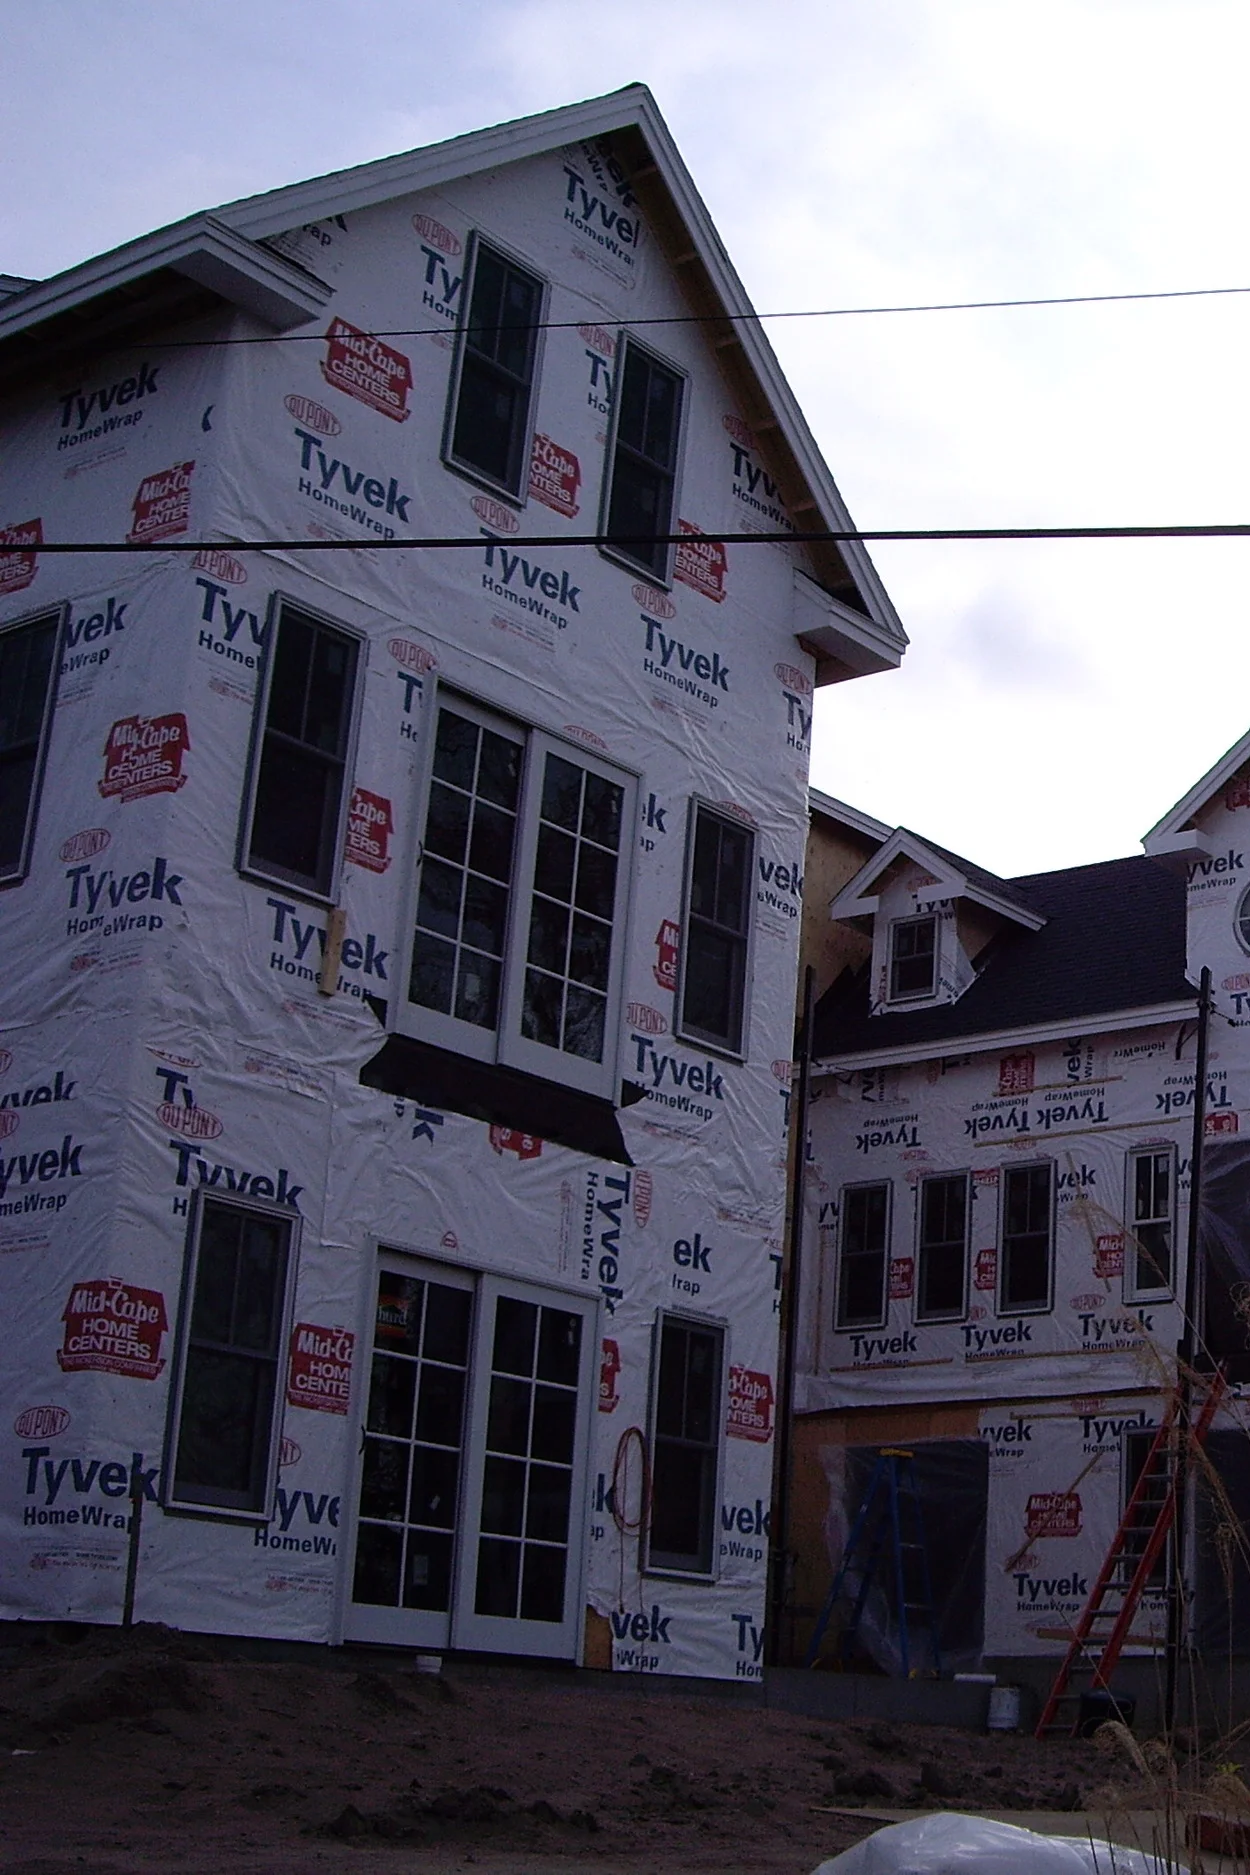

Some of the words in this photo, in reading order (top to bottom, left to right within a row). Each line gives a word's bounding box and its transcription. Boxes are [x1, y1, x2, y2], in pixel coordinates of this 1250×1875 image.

[563, 208, 635, 266] HomeWra
[331, 359, 401, 405] CENTERS
[344, 353, 392, 389] HOME
[58, 361, 160, 430] Tyvek
[57, 408, 143, 451] HomeWrap
[294, 428, 414, 523] Tyvek
[531, 461, 563, 490] OME
[534, 440, 576, 481] Cape
[142, 470, 191, 504] Mid-Ca
[530, 472, 573, 504] NTERS
[135, 504, 191, 534] CENTER
[299, 477, 396, 540] HomeWrap
[480, 527, 582, 613] Tyvek
[675, 555, 719, 588] ENTERS
[196, 577, 268, 645] Tyv
[481, 574, 568, 630] HomeWrap
[67, 597, 128, 648] vek
[60, 647, 110, 676] eWrap
[199, 631, 260, 668] Home
[640, 614, 729, 692] Tyvek
[643, 657, 719, 708] HomeWrap
[350, 793, 388, 827] Cape
[347, 831, 381, 855] TERS
[759, 855, 802, 900] vek
[1186, 850, 1244, 884] yvek
[65, 857, 183, 914] Tyvek
[1187, 876, 1237, 892] omeWrap
[756, 888, 798, 917] eWrap
[66, 914, 163, 938] HomeWrap
[630, 1033, 725, 1101] Tyvek
[1063, 1038, 1081, 1082] vek
[1084, 1046, 1094, 1079] Wrap
[0, 1071, 78, 1108] yvek
[1164, 1071, 1227, 1086] HomWrap
[646, 1090, 713, 1121] omeWrap
[864, 1114, 918, 1128] HomeWrap
[972, 1098, 1029, 1112] HomeWrap
[1036, 1101, 1109, 1129] Tyvek
[856, 1126, 921, 1154] Tyvek
[964, 1111, 1030, 1138] Tyvek
[0, 1135, 84, 1198] yvek
[170, 1139, 304, 1207] Tyvek
[1057, 1163, 1096, 1190] vek
[0, 1192, 67, 1216] meWrap
[580, 1172, 599, 1281] HomeWra
[70, 1289, 161, 1325] Mid-Cape
[82, 1318, 139, 1342] HOME
[961, 1320, 1032, 1351] Tyvek
[1078, 1310, 1154, 1340] Tyvek
[68, 1335, 153, 1361] CENTERS
[297, 1330, 352, 1362] Mid-C
[849, 1331, 917, 1361] Tyvek
[295, 1374, 349, 1397] CENTE
[309, 1361, 349, 1380] HOM
[726, 1408, 765, 1428] NTERS
[729, 1397, 756, 1414] OME
[978, 1418, 1032, 1444] yvek
[22, 1447, 161, 1504] Tyvek
[276, 1488, 340, 1531] yve
[721, 1500, 771, 1537] vek
[254, 1529, 337, 1557] HomeW
[719, 1543, 764, 1561] eWrap
[1013, 1572, 1088, 1601] Tyvek
[1017, 1600, 1080, 1612] HomeWrap
[611, 1606, 672, 1644] vek
[617, 1644, 660, 1670] Wrap
